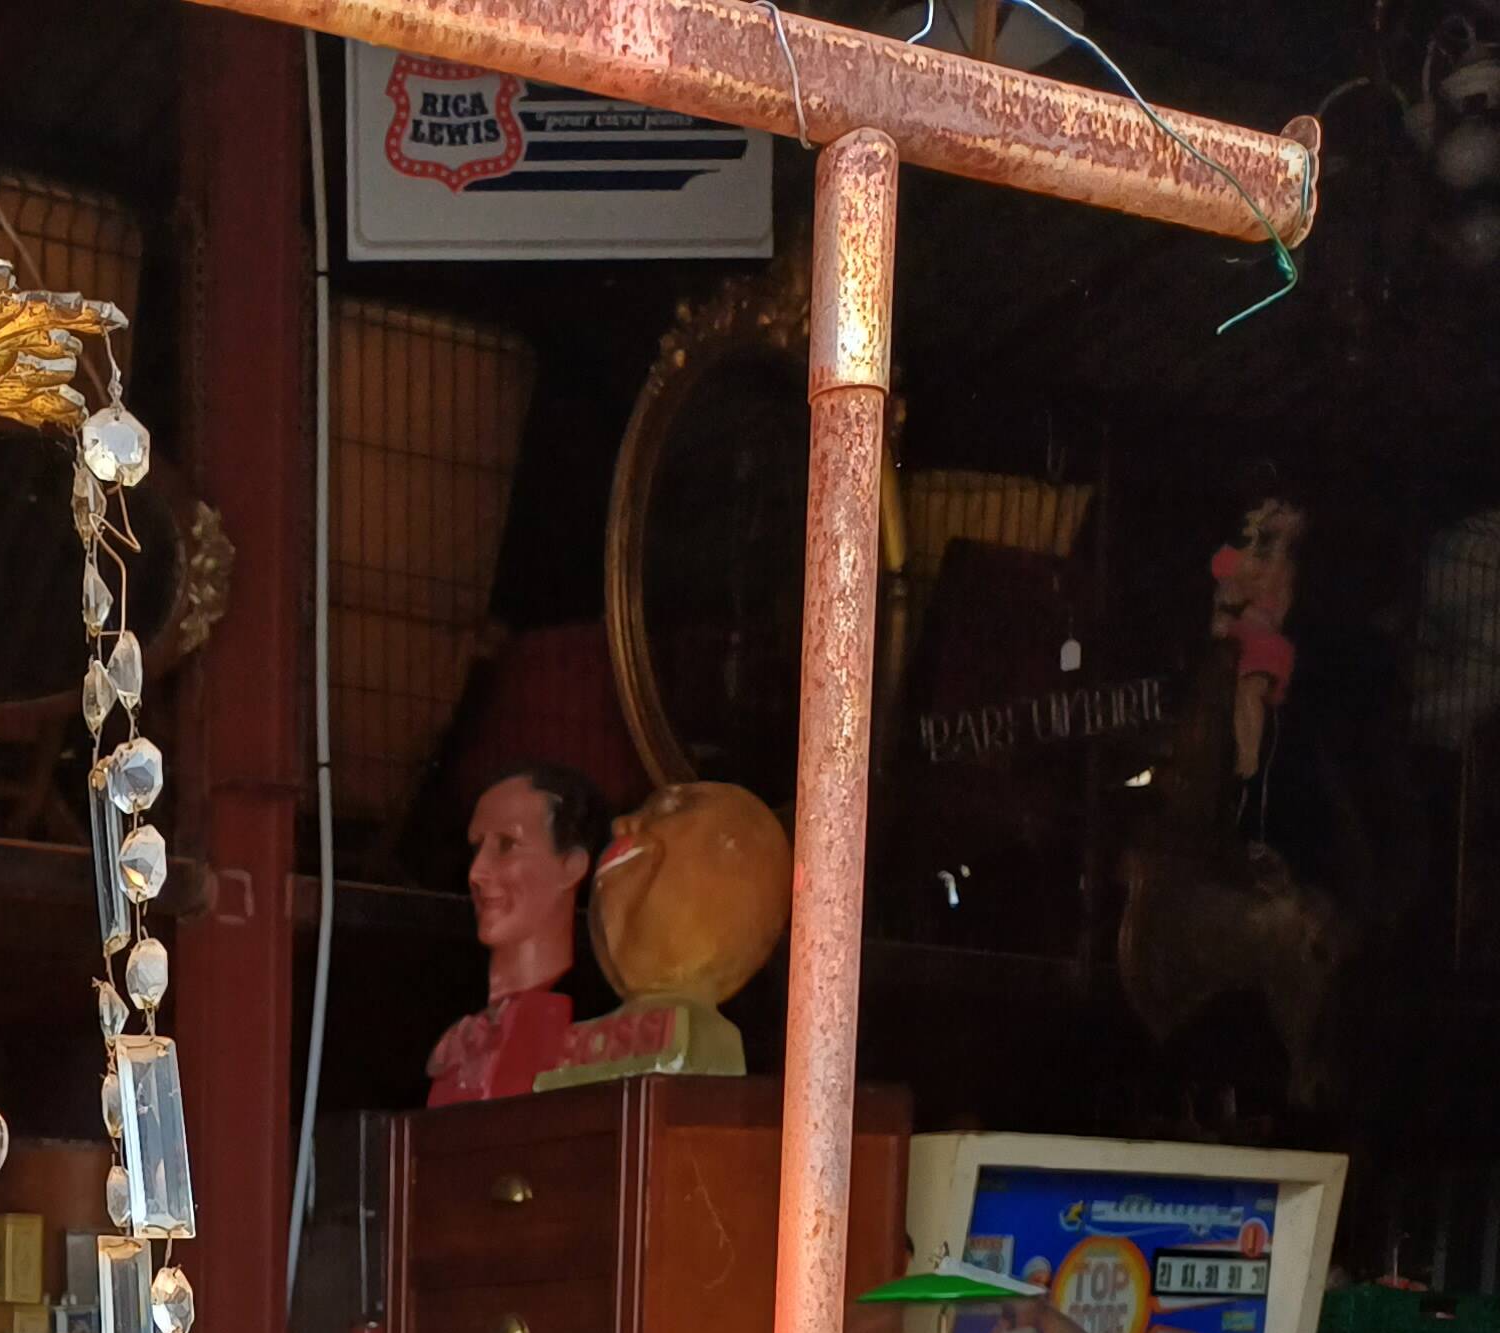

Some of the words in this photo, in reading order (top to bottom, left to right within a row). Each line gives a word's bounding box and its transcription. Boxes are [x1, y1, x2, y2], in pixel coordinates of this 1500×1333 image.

[420, 91, 489, 118] RICA
[409, 118, 501, 147] LEWIS
[1073, 1261, 1130, 1302] TOP
